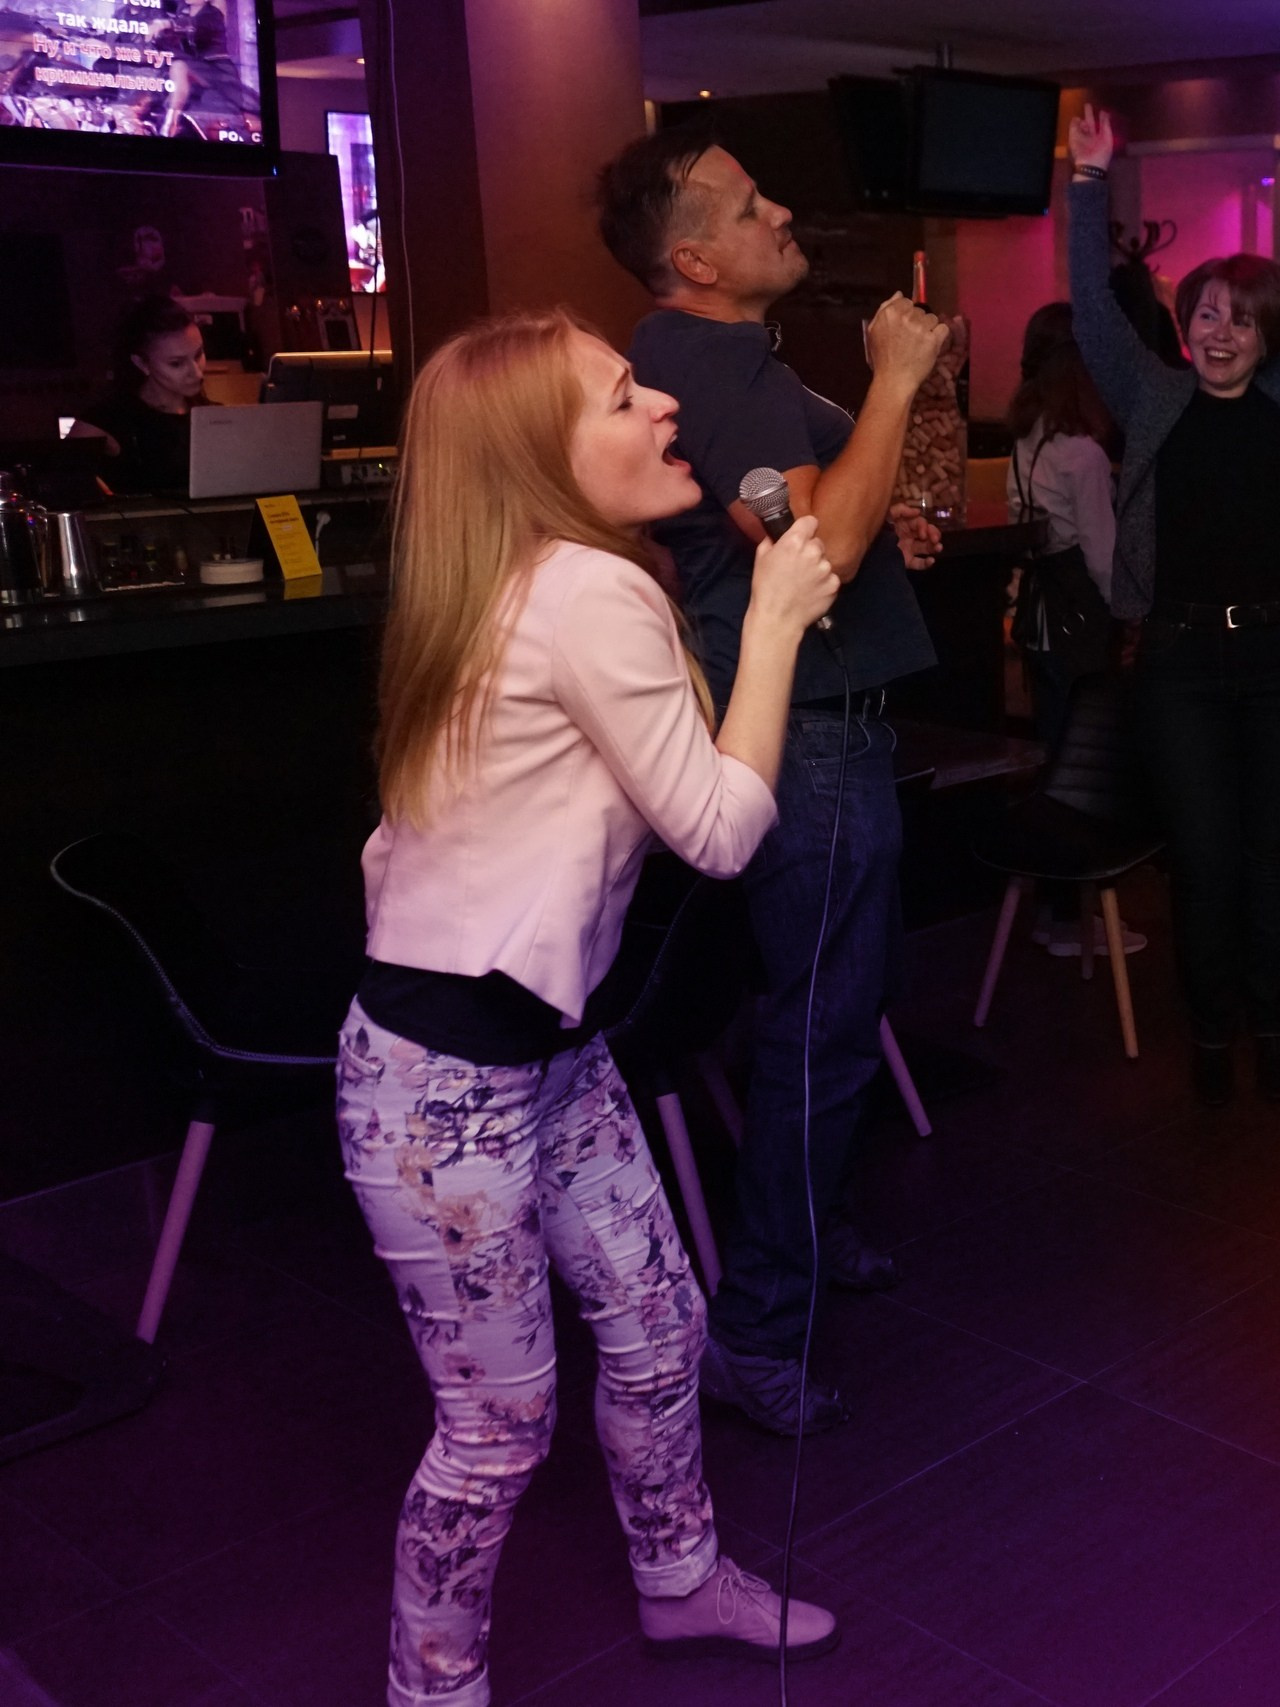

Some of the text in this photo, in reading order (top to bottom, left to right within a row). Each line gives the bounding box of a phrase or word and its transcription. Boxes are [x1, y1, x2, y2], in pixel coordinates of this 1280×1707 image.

[56, 12, 150, 35] так ждала
[33, 33, 59, 57] Ну
[63, 41, 78, 56] и
[115, 46, 142, 63] же
[143, 49, 174, 68] тут
[34, 67, 176, 93] криминального
